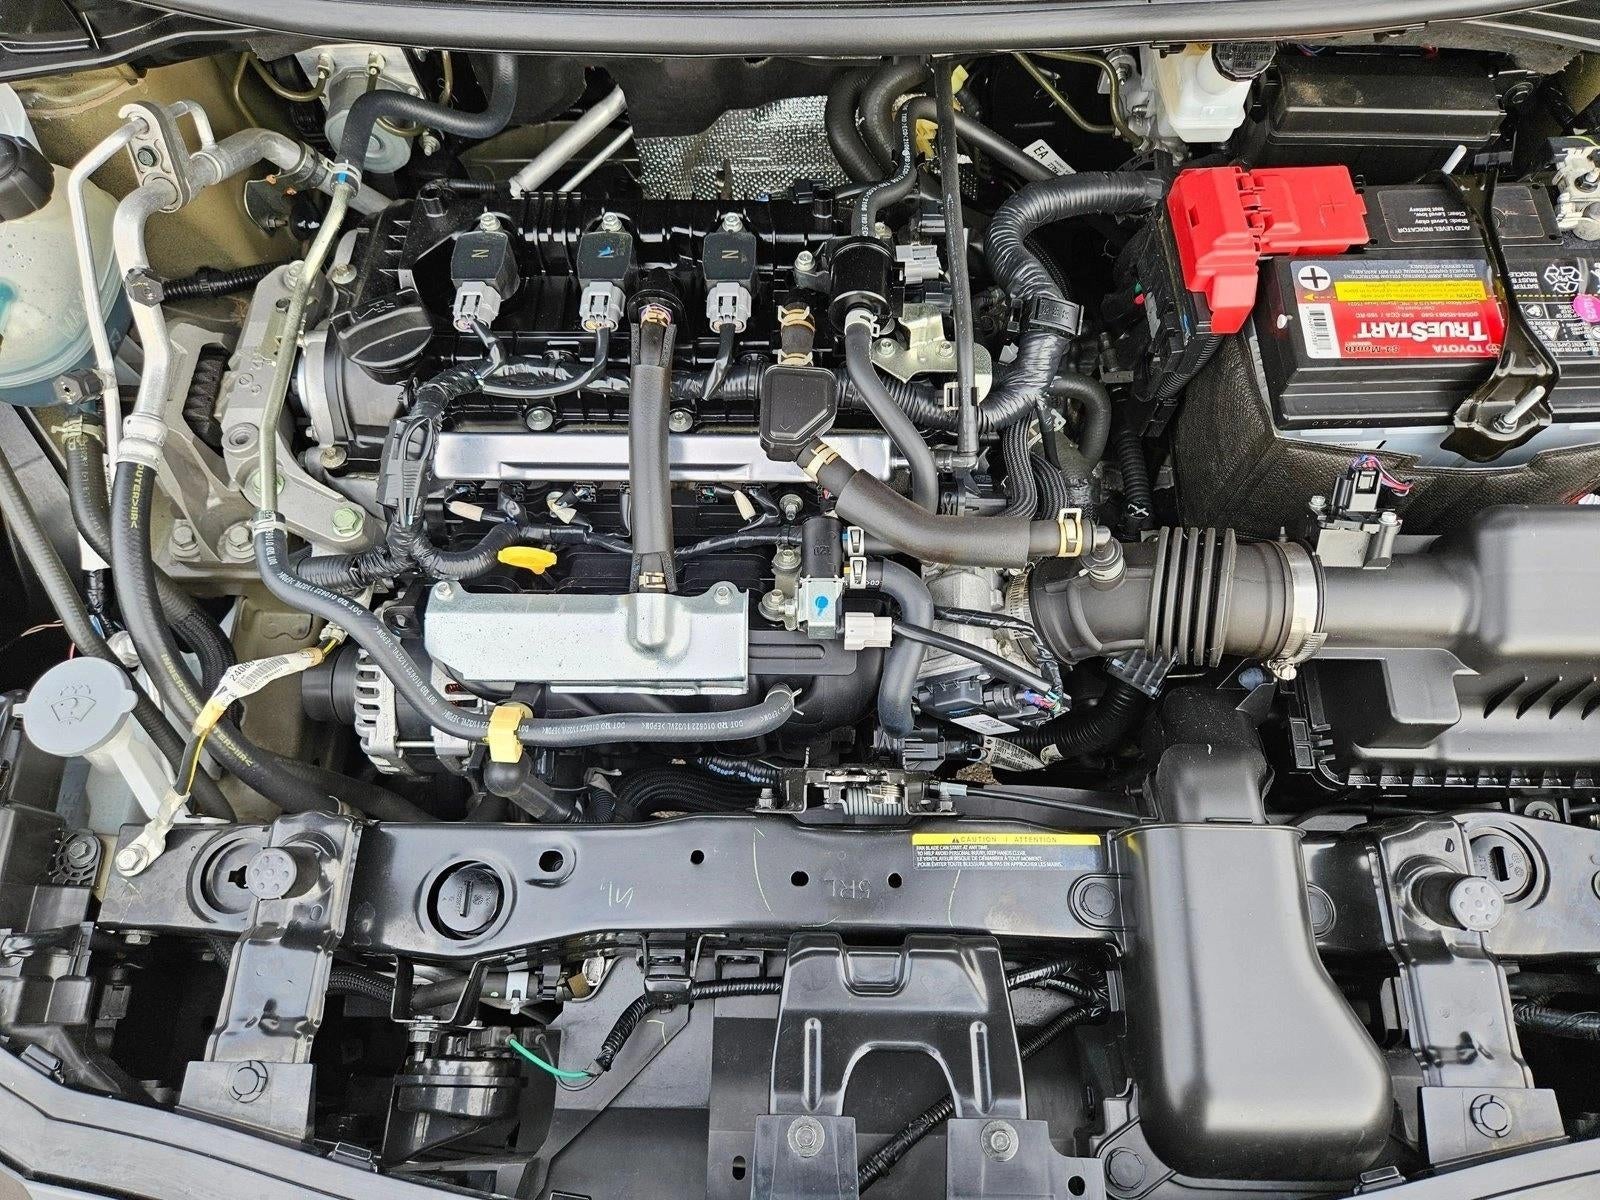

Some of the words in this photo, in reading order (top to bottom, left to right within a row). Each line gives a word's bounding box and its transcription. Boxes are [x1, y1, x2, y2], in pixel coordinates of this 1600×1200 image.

[1033, 145, 1049, 159] EA
[1432, 344, 1485, 353] TOYOTA
[349, 604, 364, 616] DOT
[612, 721, 626, 729] DOT
[729, 719, 744, 728] DOT
